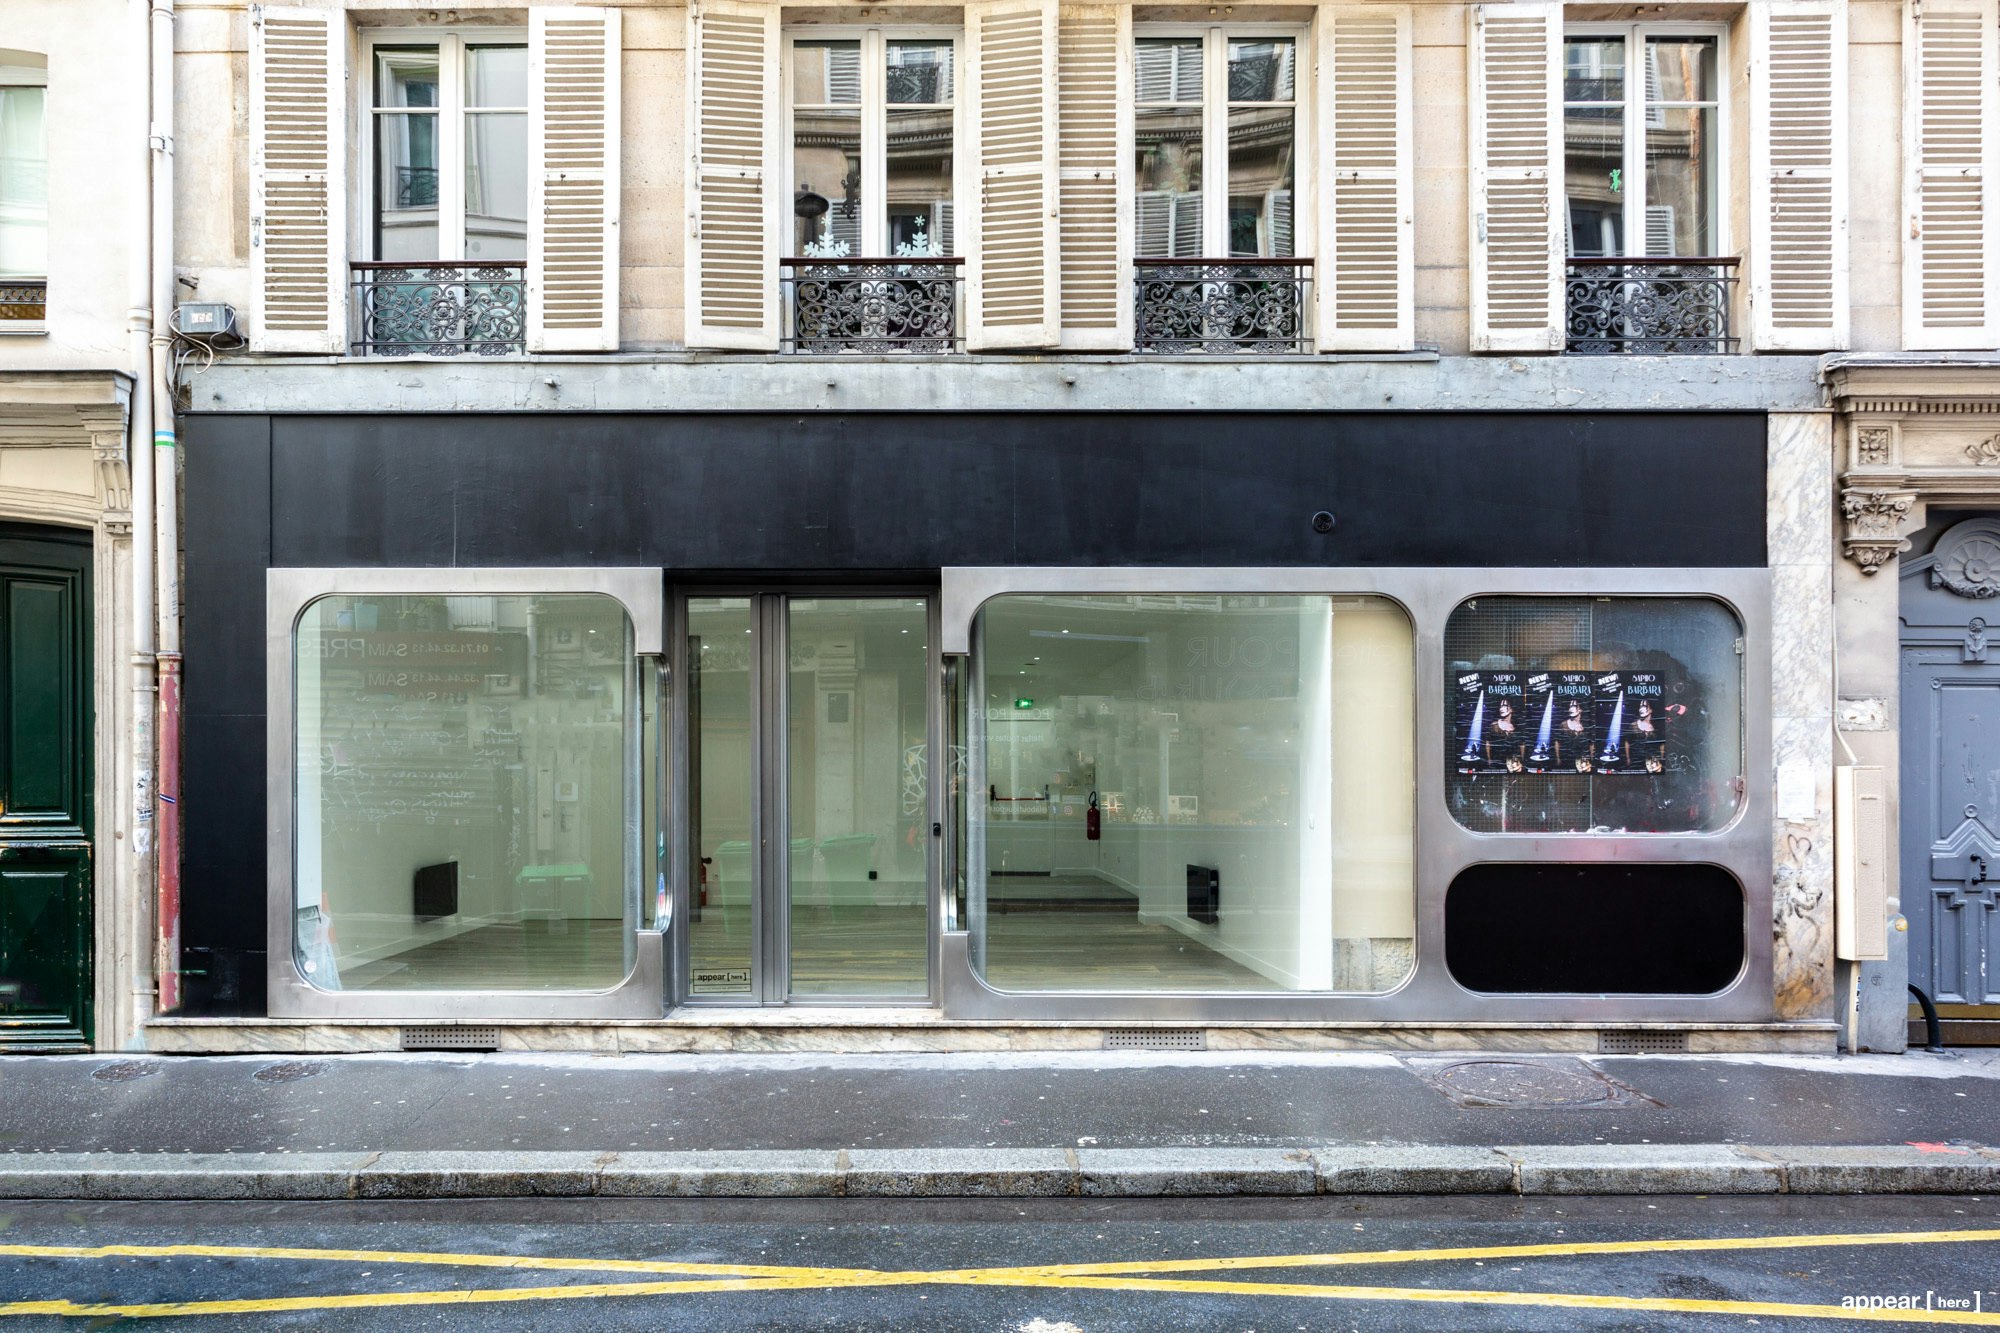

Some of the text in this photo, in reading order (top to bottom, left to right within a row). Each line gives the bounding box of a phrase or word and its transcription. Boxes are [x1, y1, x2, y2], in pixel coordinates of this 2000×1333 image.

[1488, 685, 1522, 696] BARBARA
[1557, 685, 1591, 696] BARBARA
[1627, 685, 1662, 696] BARBARA
[697, 974, 726, 982] appear
